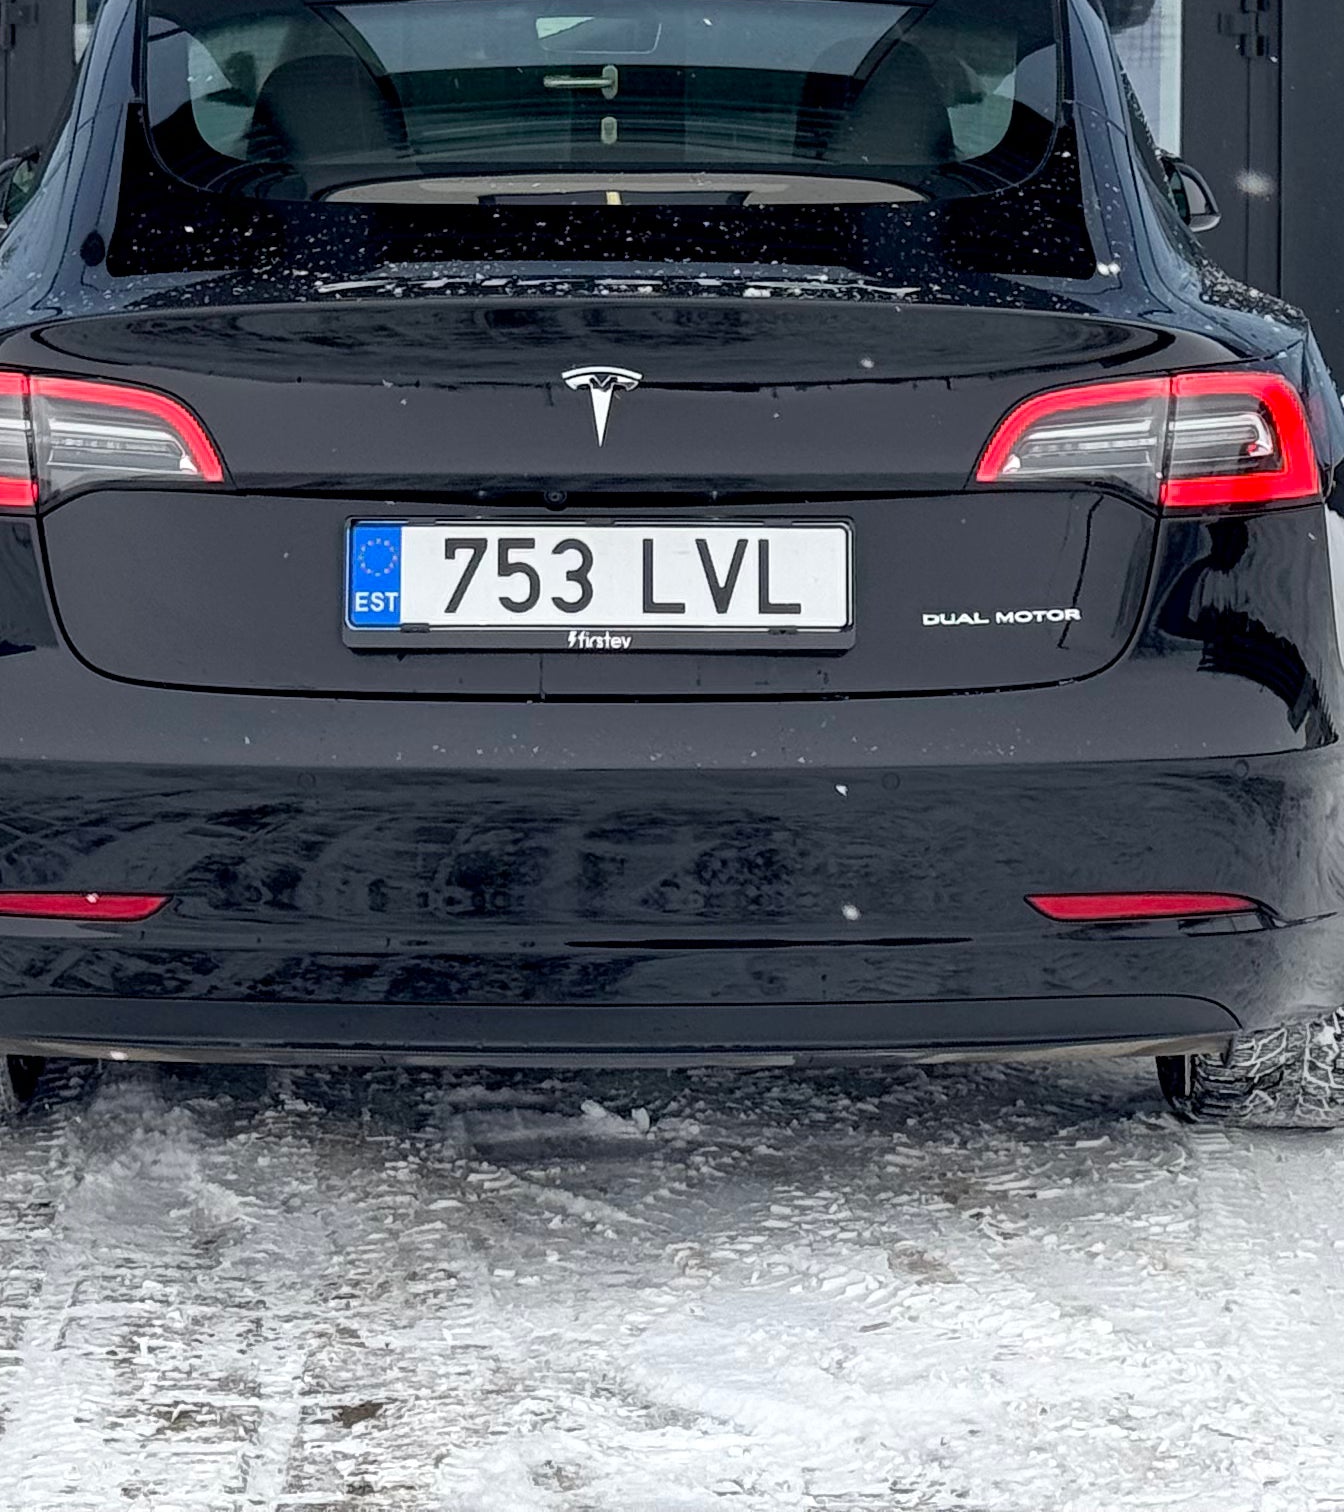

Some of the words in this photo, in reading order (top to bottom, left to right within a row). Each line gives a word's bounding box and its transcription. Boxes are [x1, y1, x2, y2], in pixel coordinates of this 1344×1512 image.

[355, 591, 399, 613] EST
[444, 538, 594, 615] 753
[642, 538, 802, 615] LVL
[922, 611, 990, 626] DUAL
[995, 608, 1082, 625] MOTOR
[578, 630, 632, 650] firstev
